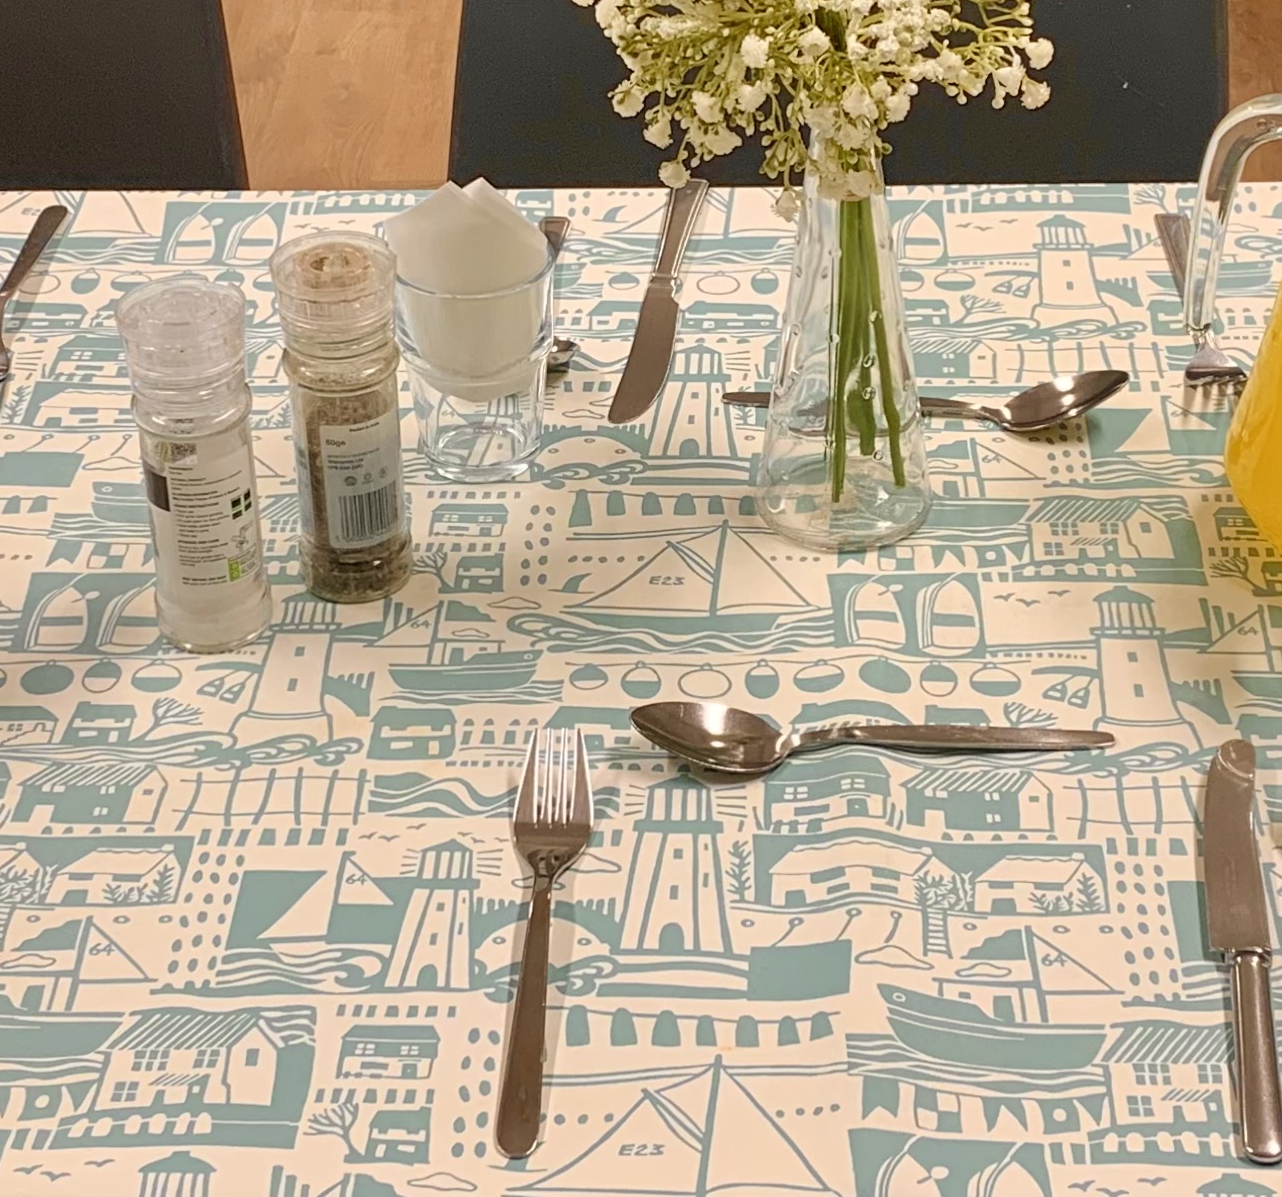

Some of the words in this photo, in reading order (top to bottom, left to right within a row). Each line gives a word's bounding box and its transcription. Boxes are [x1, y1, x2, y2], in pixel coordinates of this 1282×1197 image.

[981, 453, 1002, 464] 64
[649, 576, 685, 586] E23
[411, 619, 432, 630] 64
[1237, 626, 1258, 637] 64
[345, 873, 367, 886] 64
[89, 942, 115, 956] 64
[1041, 953, 1068, 967] 64
[618, 1143, 666, 1156] E23
